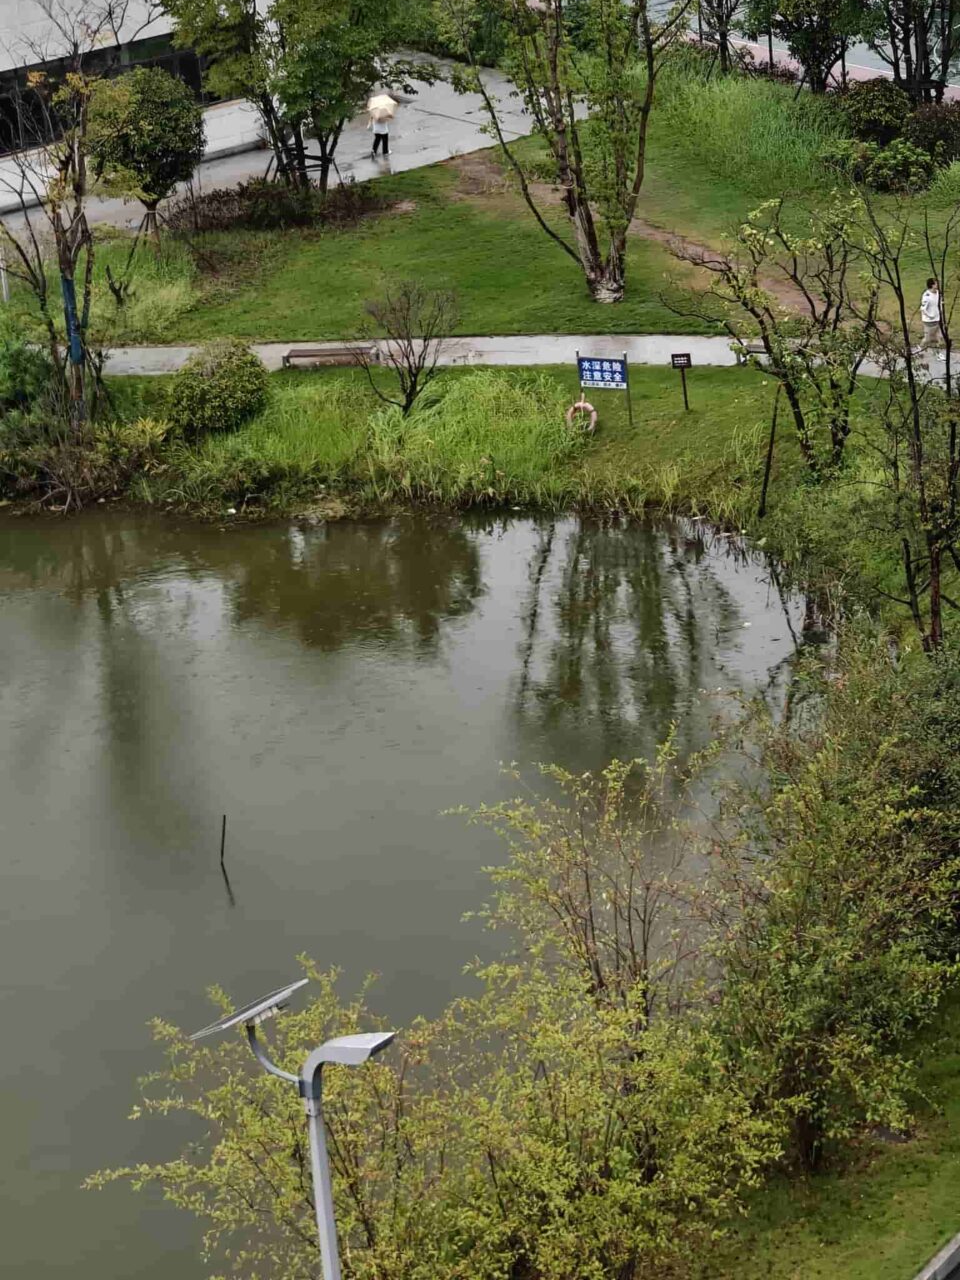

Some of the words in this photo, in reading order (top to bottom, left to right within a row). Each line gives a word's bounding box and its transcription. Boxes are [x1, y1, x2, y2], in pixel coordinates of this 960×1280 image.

[582, 361, 622, 372] 水深危险
[583, 371, 622, 381] 注意安全
